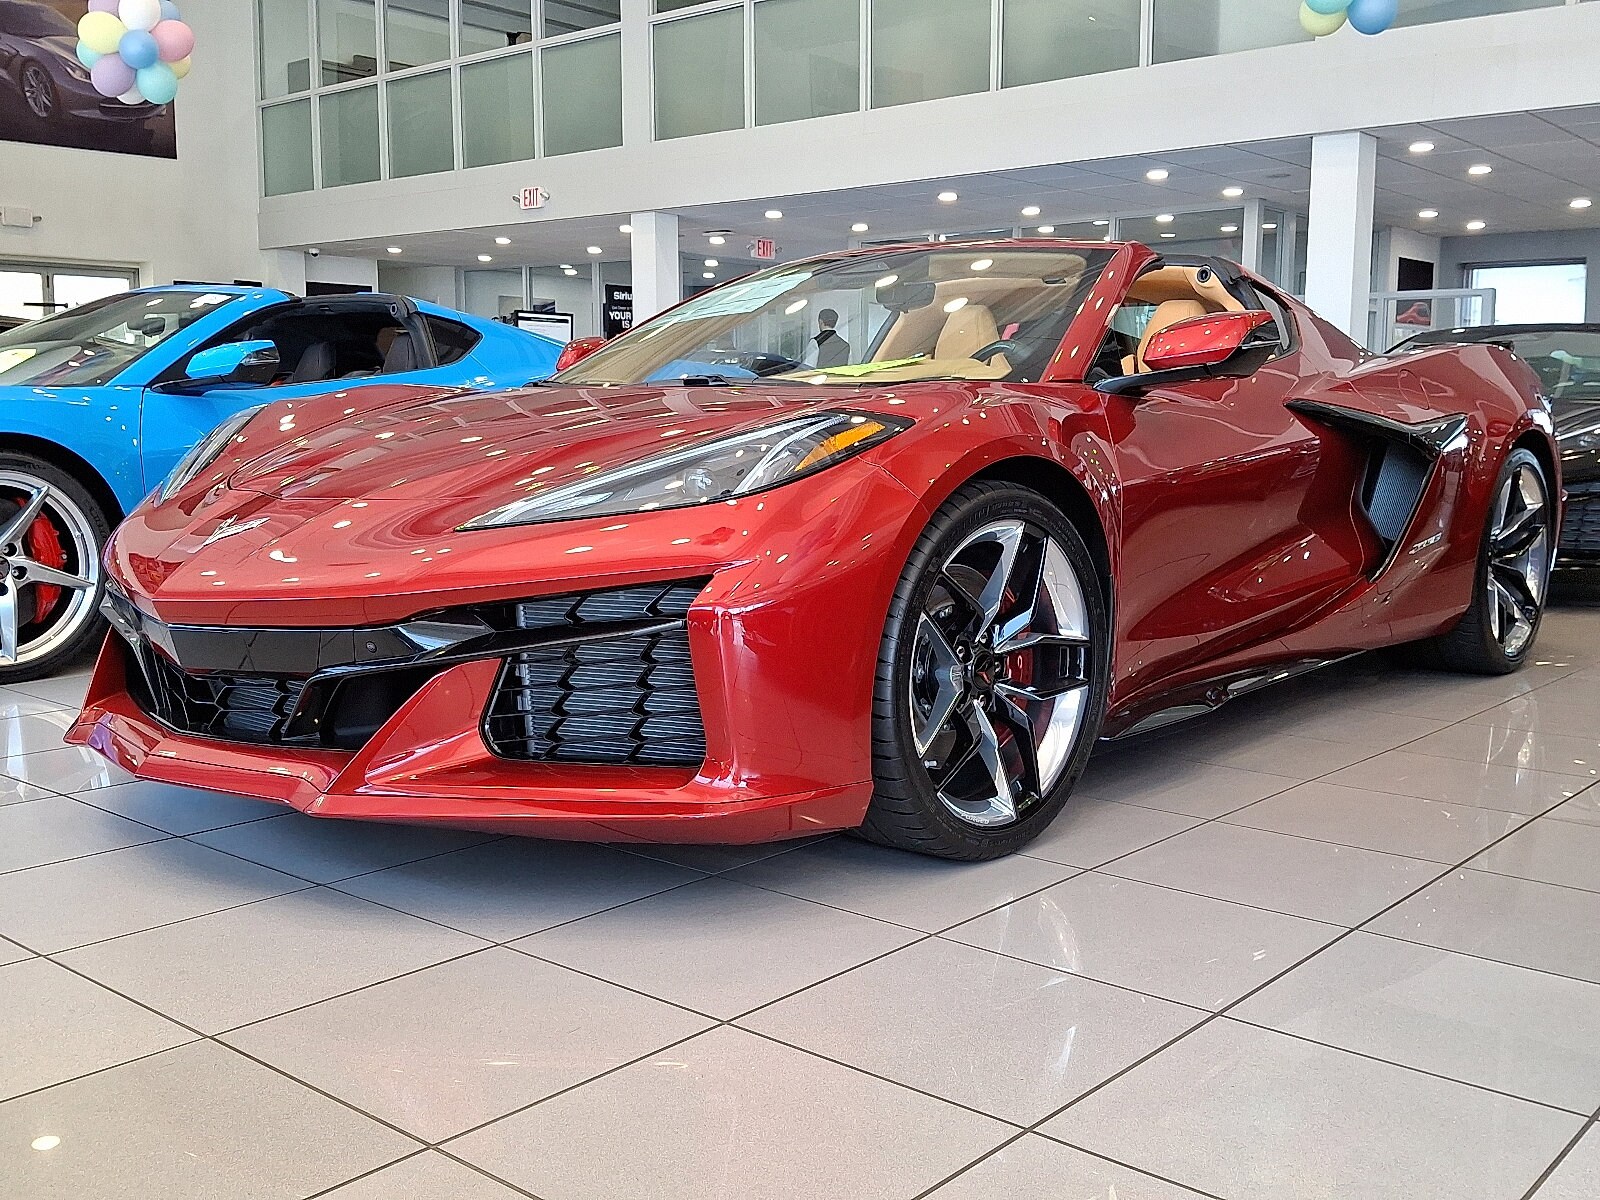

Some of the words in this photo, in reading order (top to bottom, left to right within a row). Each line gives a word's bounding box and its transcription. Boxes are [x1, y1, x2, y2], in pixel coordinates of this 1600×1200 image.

[523, 187, 539, 207] EXIT
[757, 239, 773, 257] EXIT
[609, 311, 632, 320] YOUR
[622, 320, 630, 329] IS
